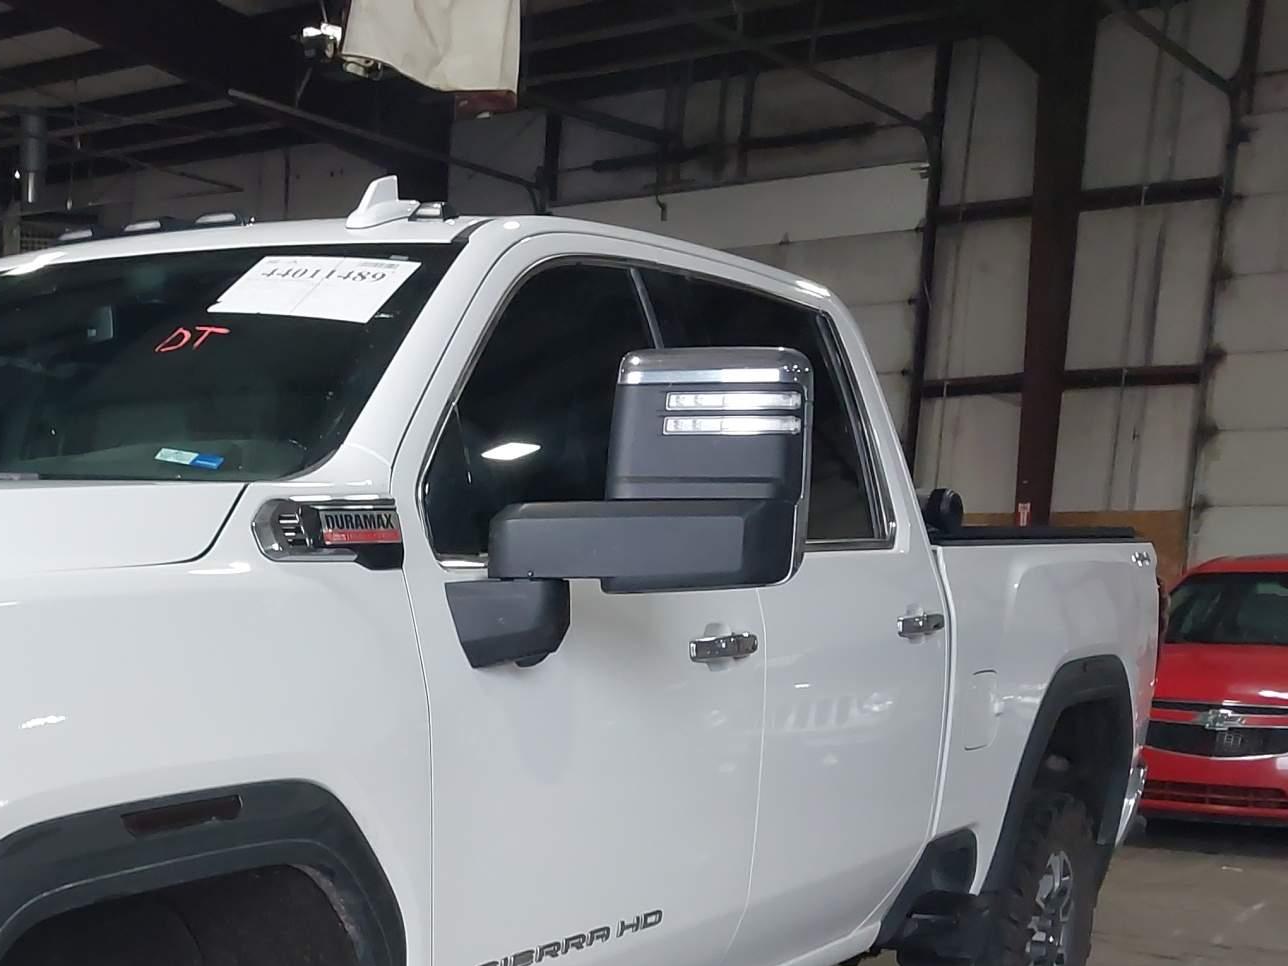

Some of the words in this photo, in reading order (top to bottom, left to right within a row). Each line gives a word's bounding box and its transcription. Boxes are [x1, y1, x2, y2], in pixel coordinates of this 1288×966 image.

[261, 266, 387, 283] 44011489
[154, 327, 230, 353] DT
[324, 513, 394, 530] DURAMAX
[616, 909, 663, 938] HD
